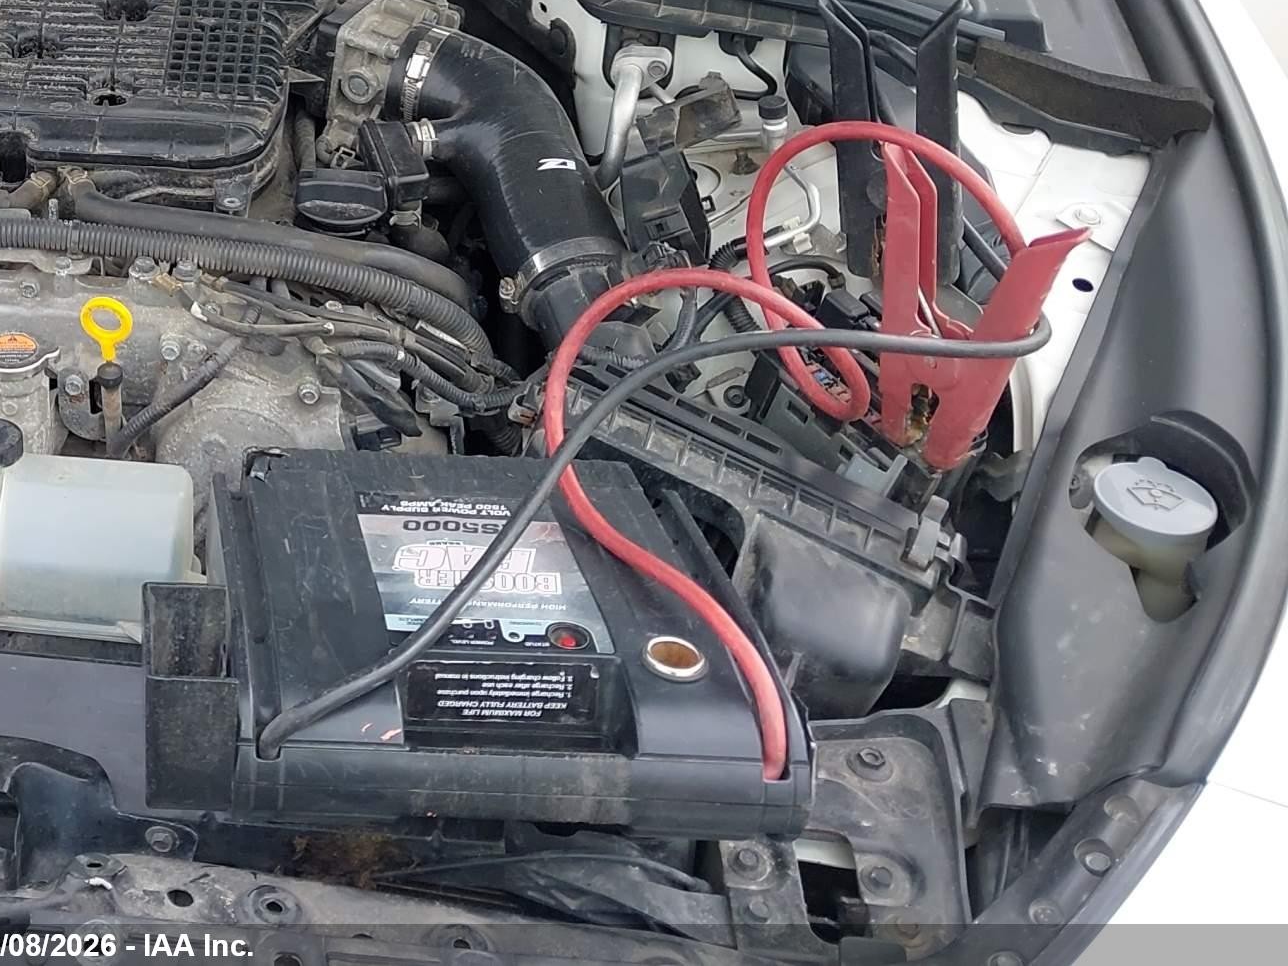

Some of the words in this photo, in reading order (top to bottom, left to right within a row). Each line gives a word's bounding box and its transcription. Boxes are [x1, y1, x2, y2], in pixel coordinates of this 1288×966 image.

[381, 504, 429, 513] SUPPLY
[432, 506, 477, 514] POWER
[480, 509, 511, 517] VOLT
[402, 520, 506, 534] S5000
[465, 600, 539, 610] PERFORMAN
[540, 603, 567, 611] HIGH
[511, 673, 541, 681] charging
[532, 682, 565, 690] Recharge
[488, 690, 530, 698] immediately
[532, 690, 565, 698] Recharge
[481, 709, 523, 717] MAXIMUM
